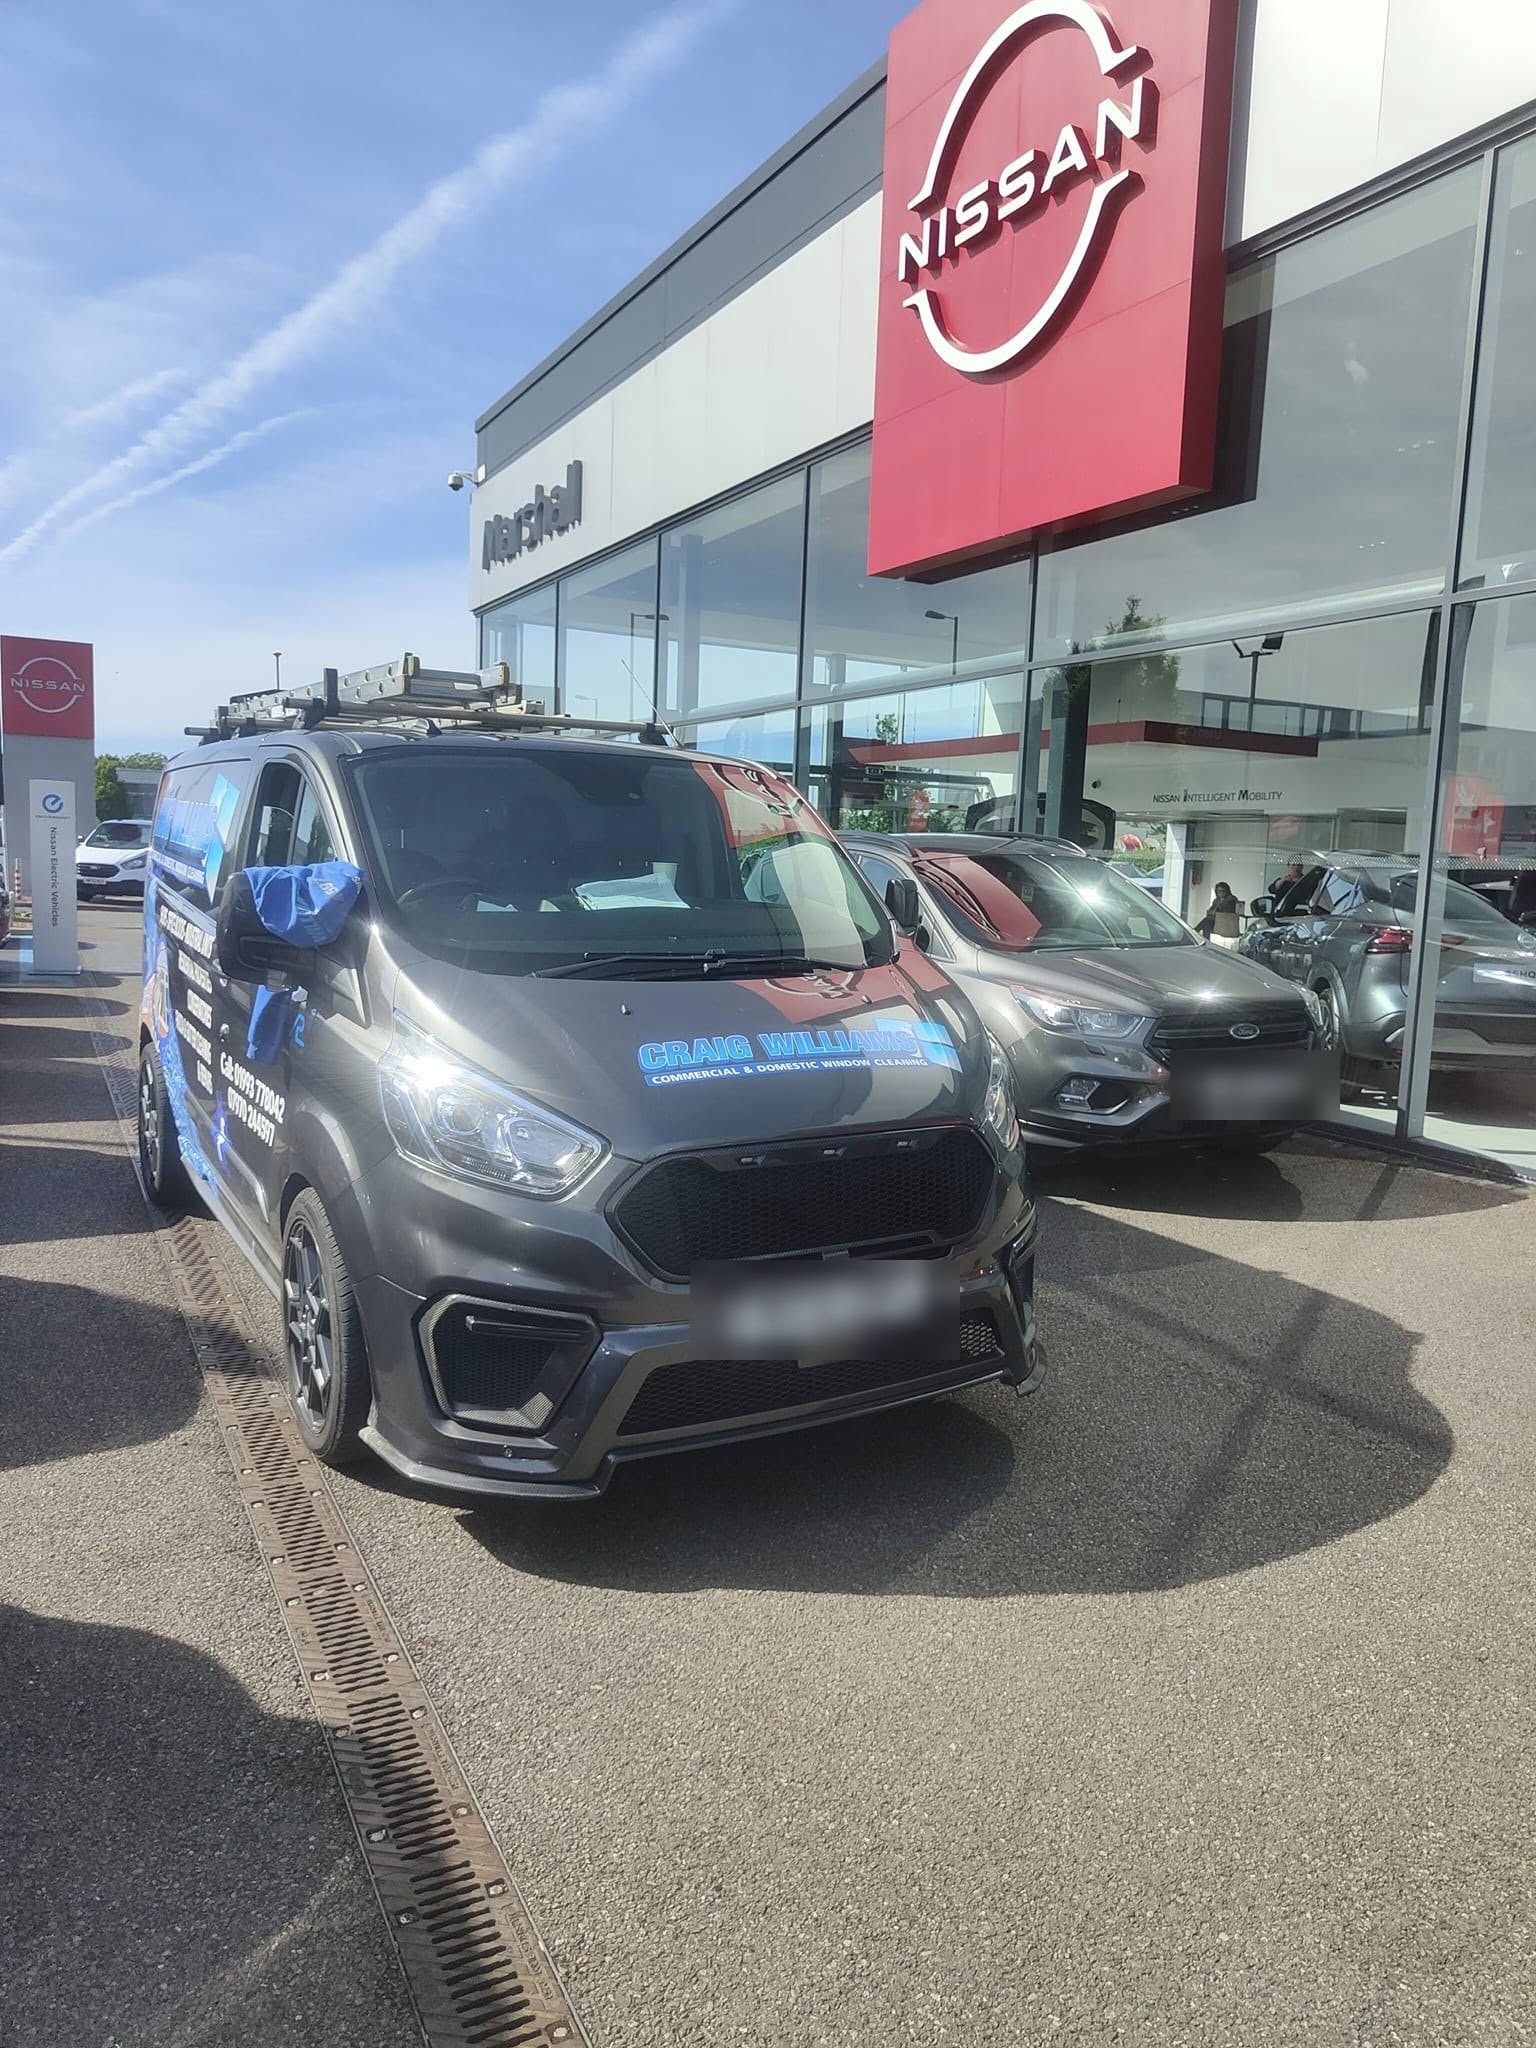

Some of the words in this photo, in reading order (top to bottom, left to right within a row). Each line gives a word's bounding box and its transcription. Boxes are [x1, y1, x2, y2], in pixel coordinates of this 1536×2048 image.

[898, 75, 1153, 284] NISSAN
[10, 676, 86, 693] NISSAN
[1152, 793, 1181, 803] NISSAN
[1183, 789, 1237, 802] INTELLIGENT
[1237, 789, 1283, 801] MOBILITY
[50, 826, 58, 856] Nissan
[51, 857, 59, 889] Electric
[51, 890, 60, 927] Vehicles
[637, 1033, 753, 1070] CRAIG
[756, 1026, 922, 1061] WILLIAMS
[651, 1066, 740, 1086] COMMERCIAL
[743, 1064, 753, 1074] &
[756, 1060, 819, 1074] DOMESTIC
[821, 1058, 870, 1070] WINDOW
[873, 1057, 928, 1068] CLEANING
